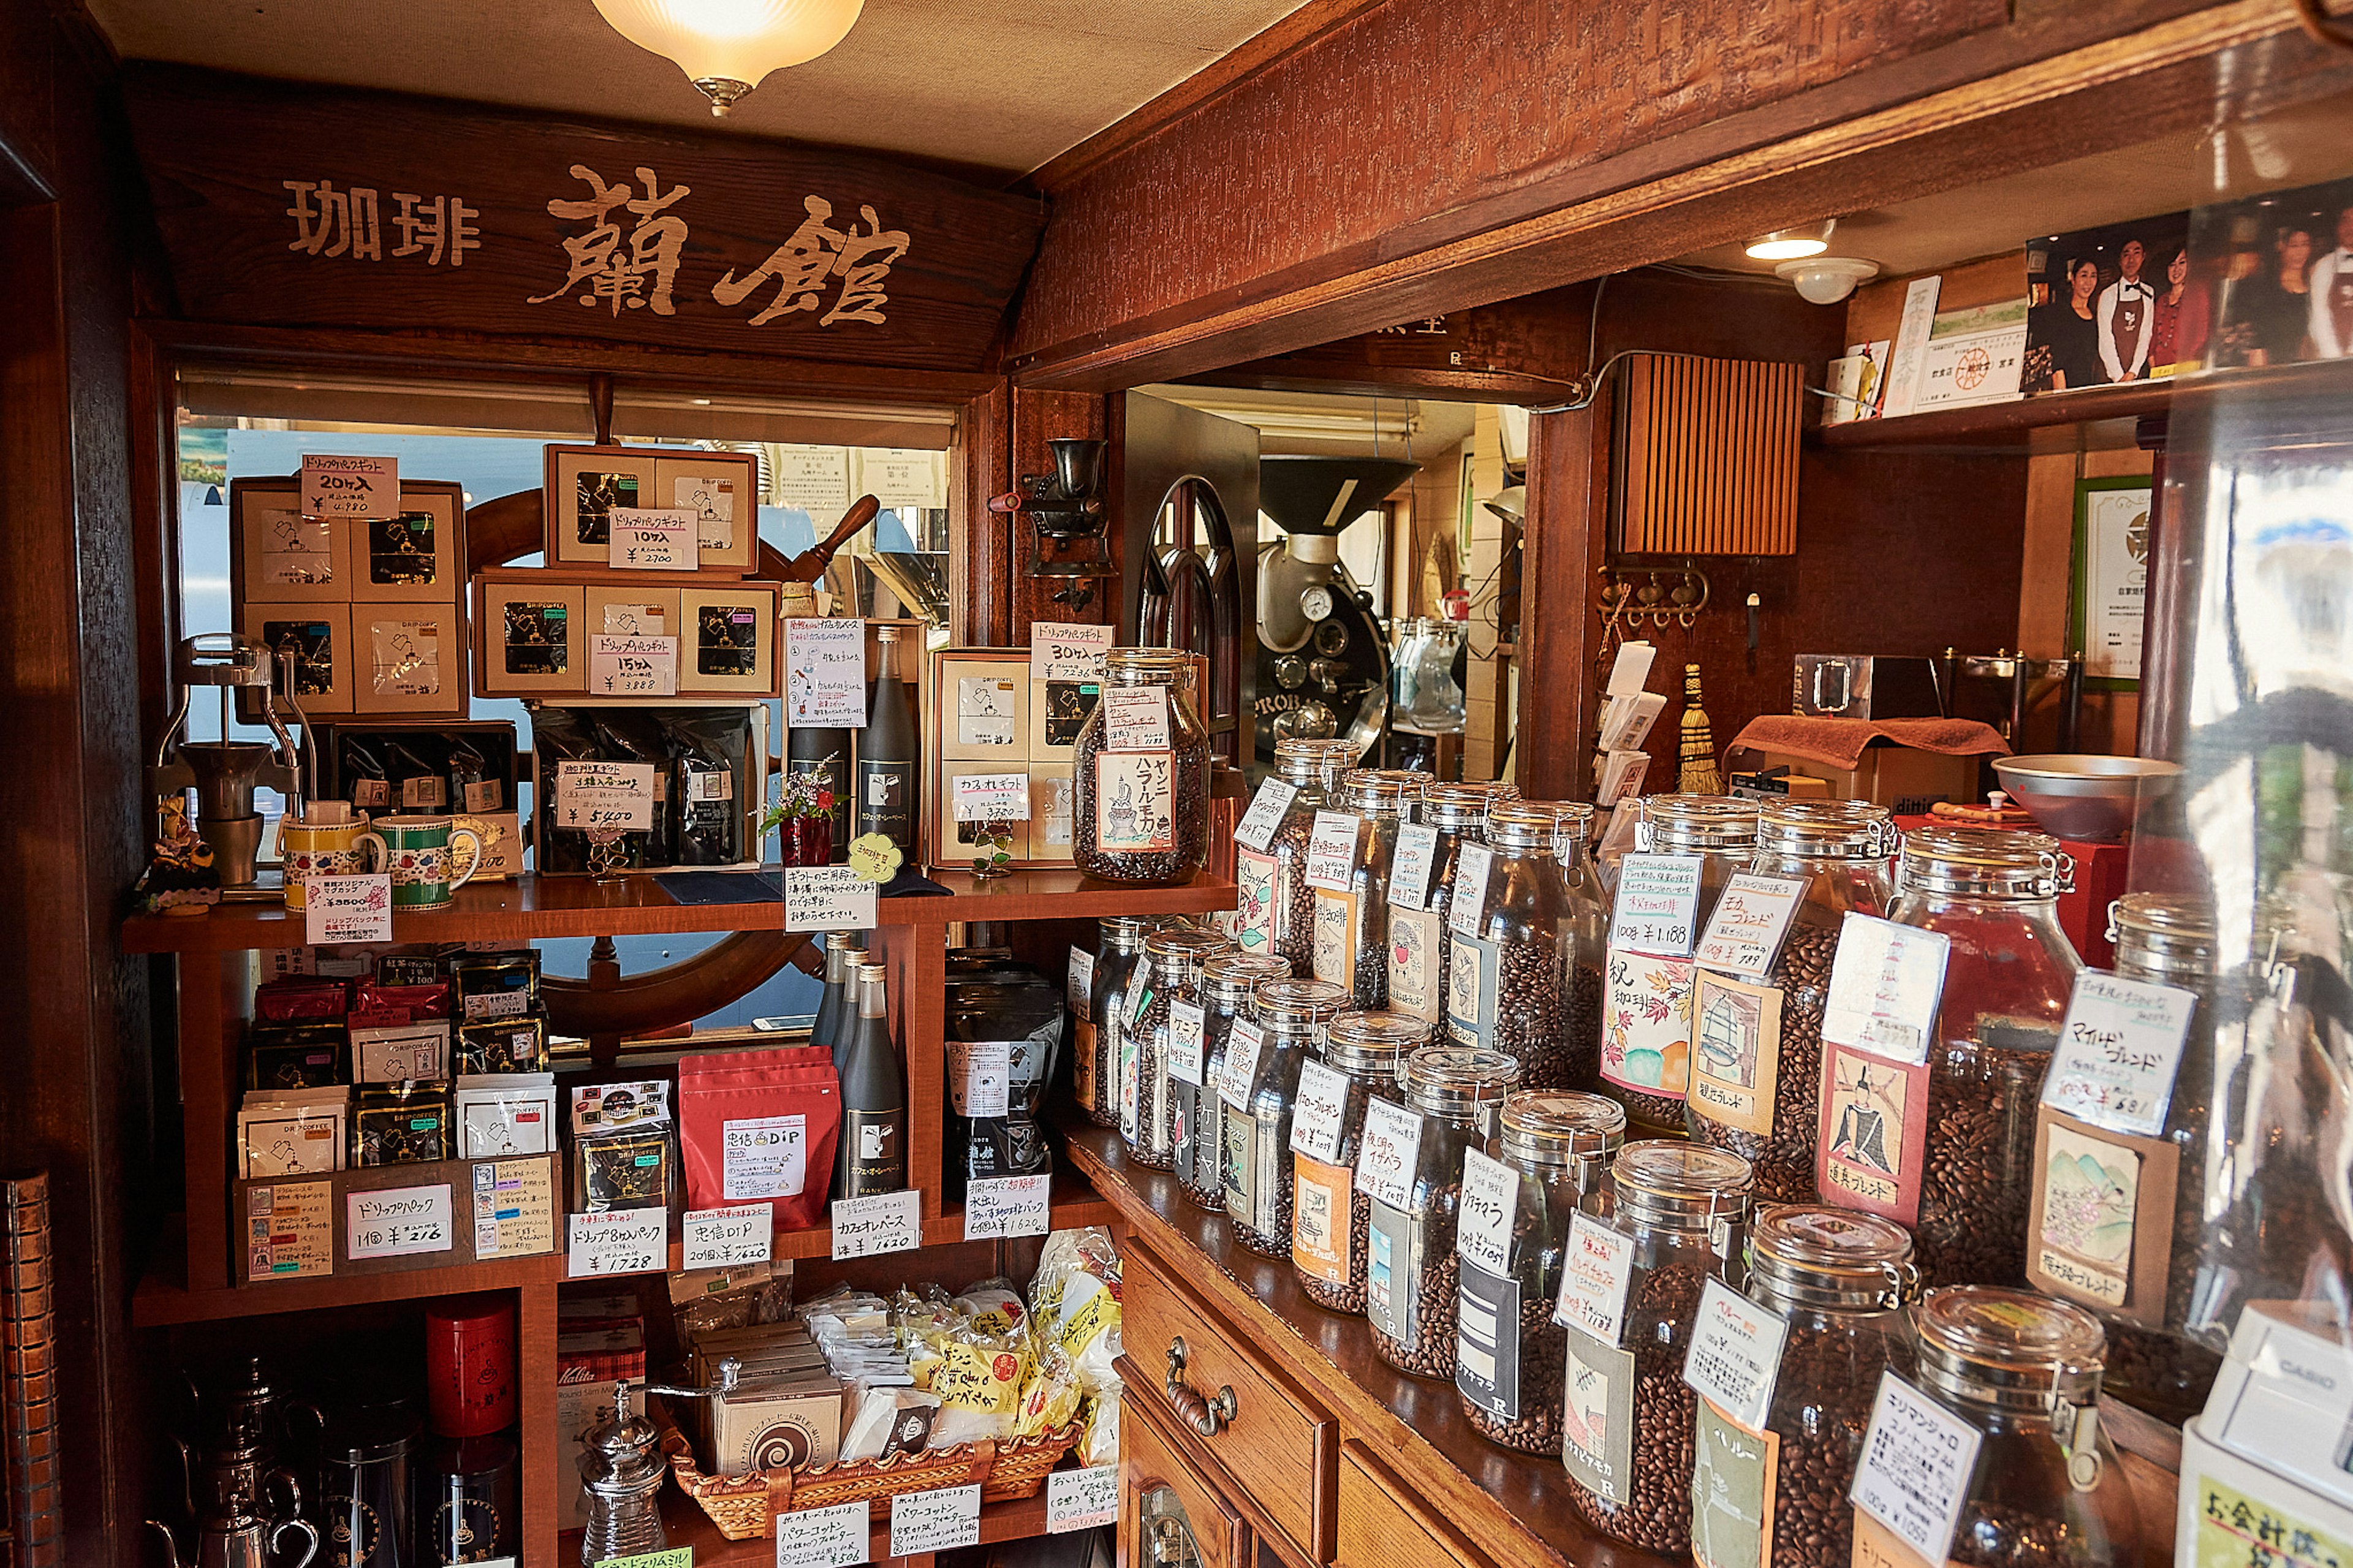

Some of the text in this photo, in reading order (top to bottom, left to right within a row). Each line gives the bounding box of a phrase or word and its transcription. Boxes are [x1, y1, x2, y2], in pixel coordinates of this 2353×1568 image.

[282, 180, 480, 266] 珈琲
[1136, 757, 1155, 833] ハラールモカ
[1644, 923, 1654, 944] ¥
[2073, 1022, 2124, 1050] マイルド
[359, 1199, 434, 1218] ドリップパック
[357, 1231, 382, 1248] 1個
[388, 1226, 400, 1246] ¥
[1327, 1268, 1338, 1278] R
[1716, 1299, 1742, 1320] ペルー
[1385, 1319, 1397, 1335] R
[558, 1366, 596, 1384] Kalita
[2279, 1358, 2336, 1393] CASIO
[558, 1387, 600, 1399] Round Slim
[1491, 1396, 1507, 1414] R
[1599, 1479, 1616, 1498] R
